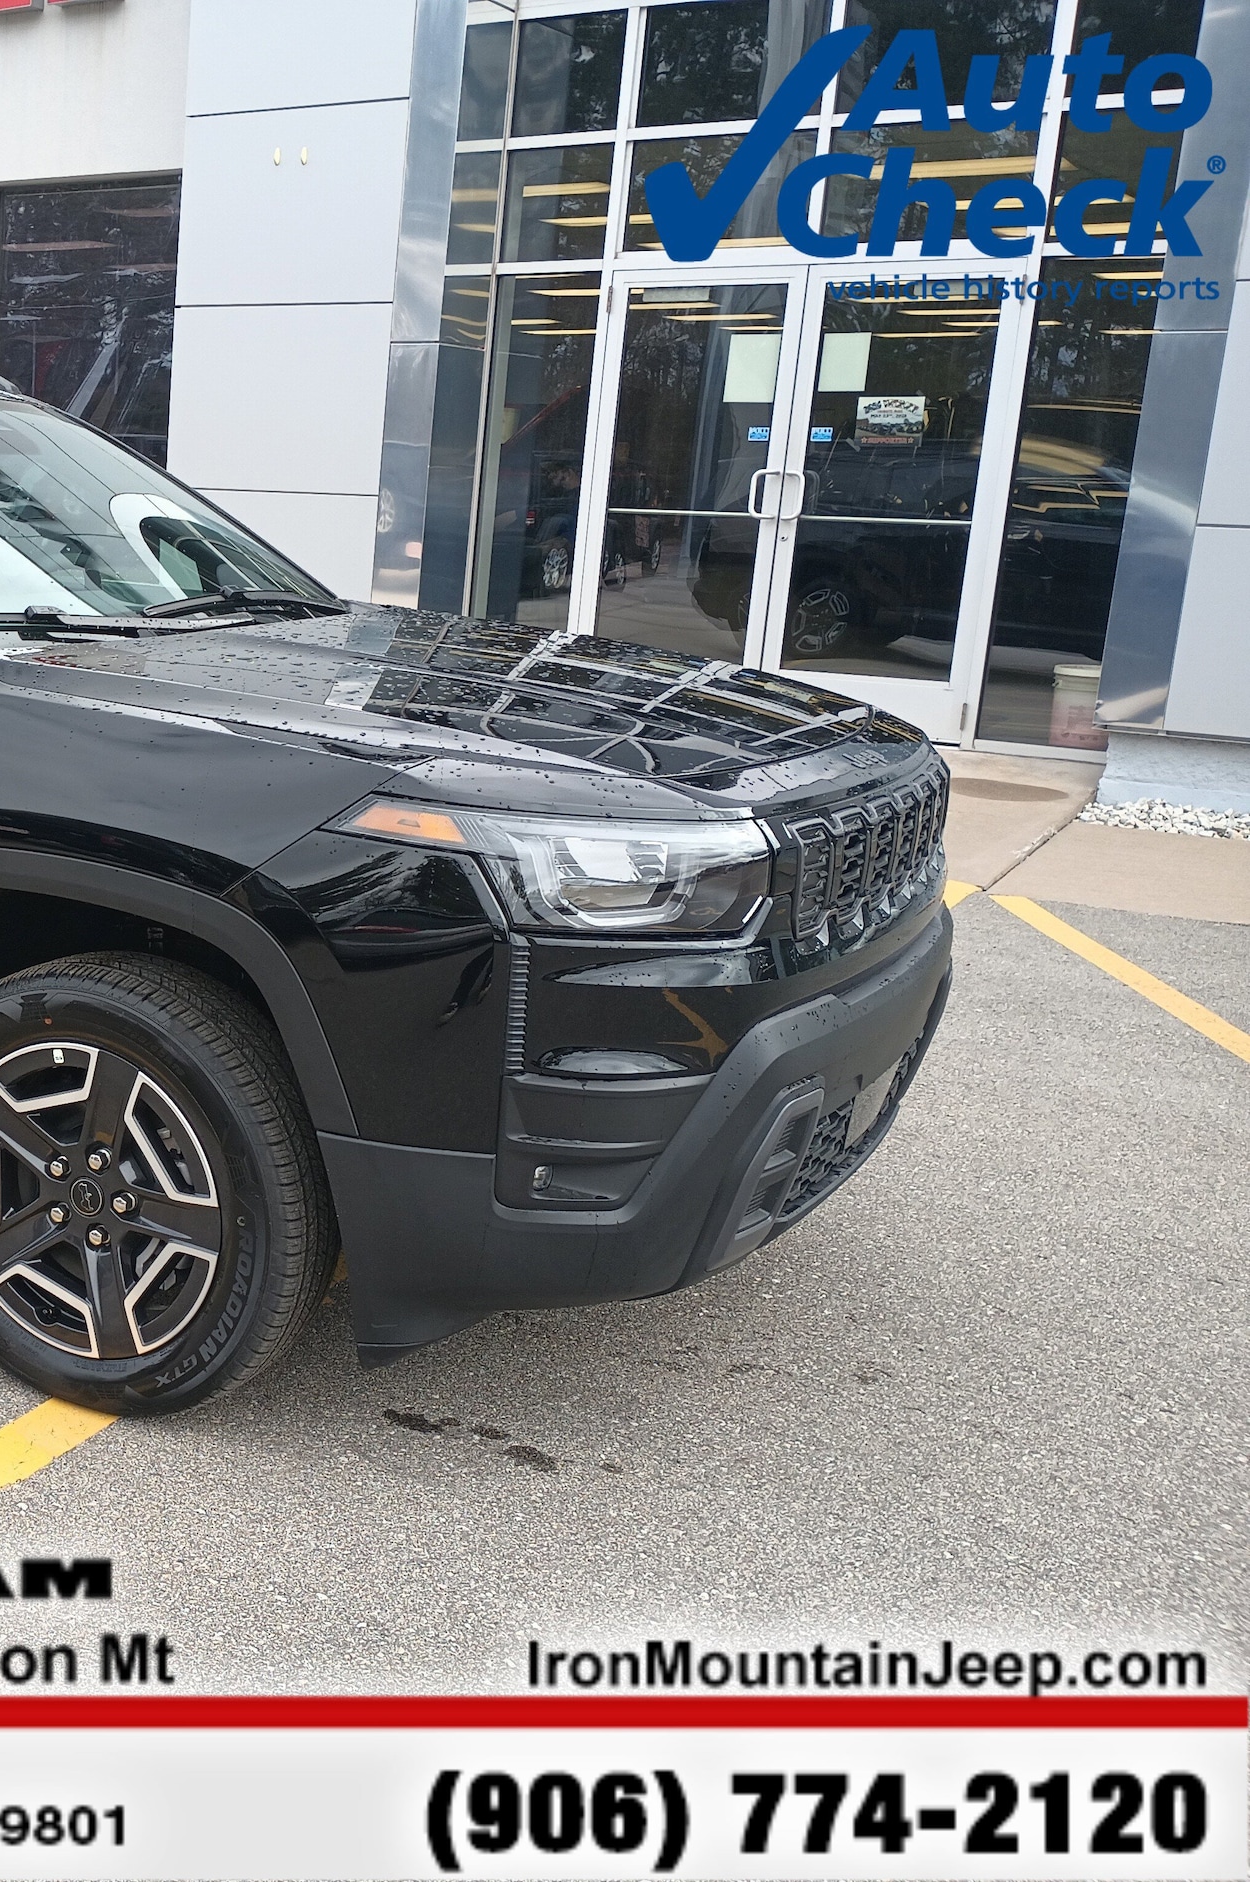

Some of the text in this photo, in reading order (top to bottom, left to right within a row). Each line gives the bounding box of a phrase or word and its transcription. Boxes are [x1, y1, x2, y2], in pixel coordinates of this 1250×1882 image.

[842, 750, 888, 769] Jeep
[154, 1229, 255, 1388] ROADIAN GTX
